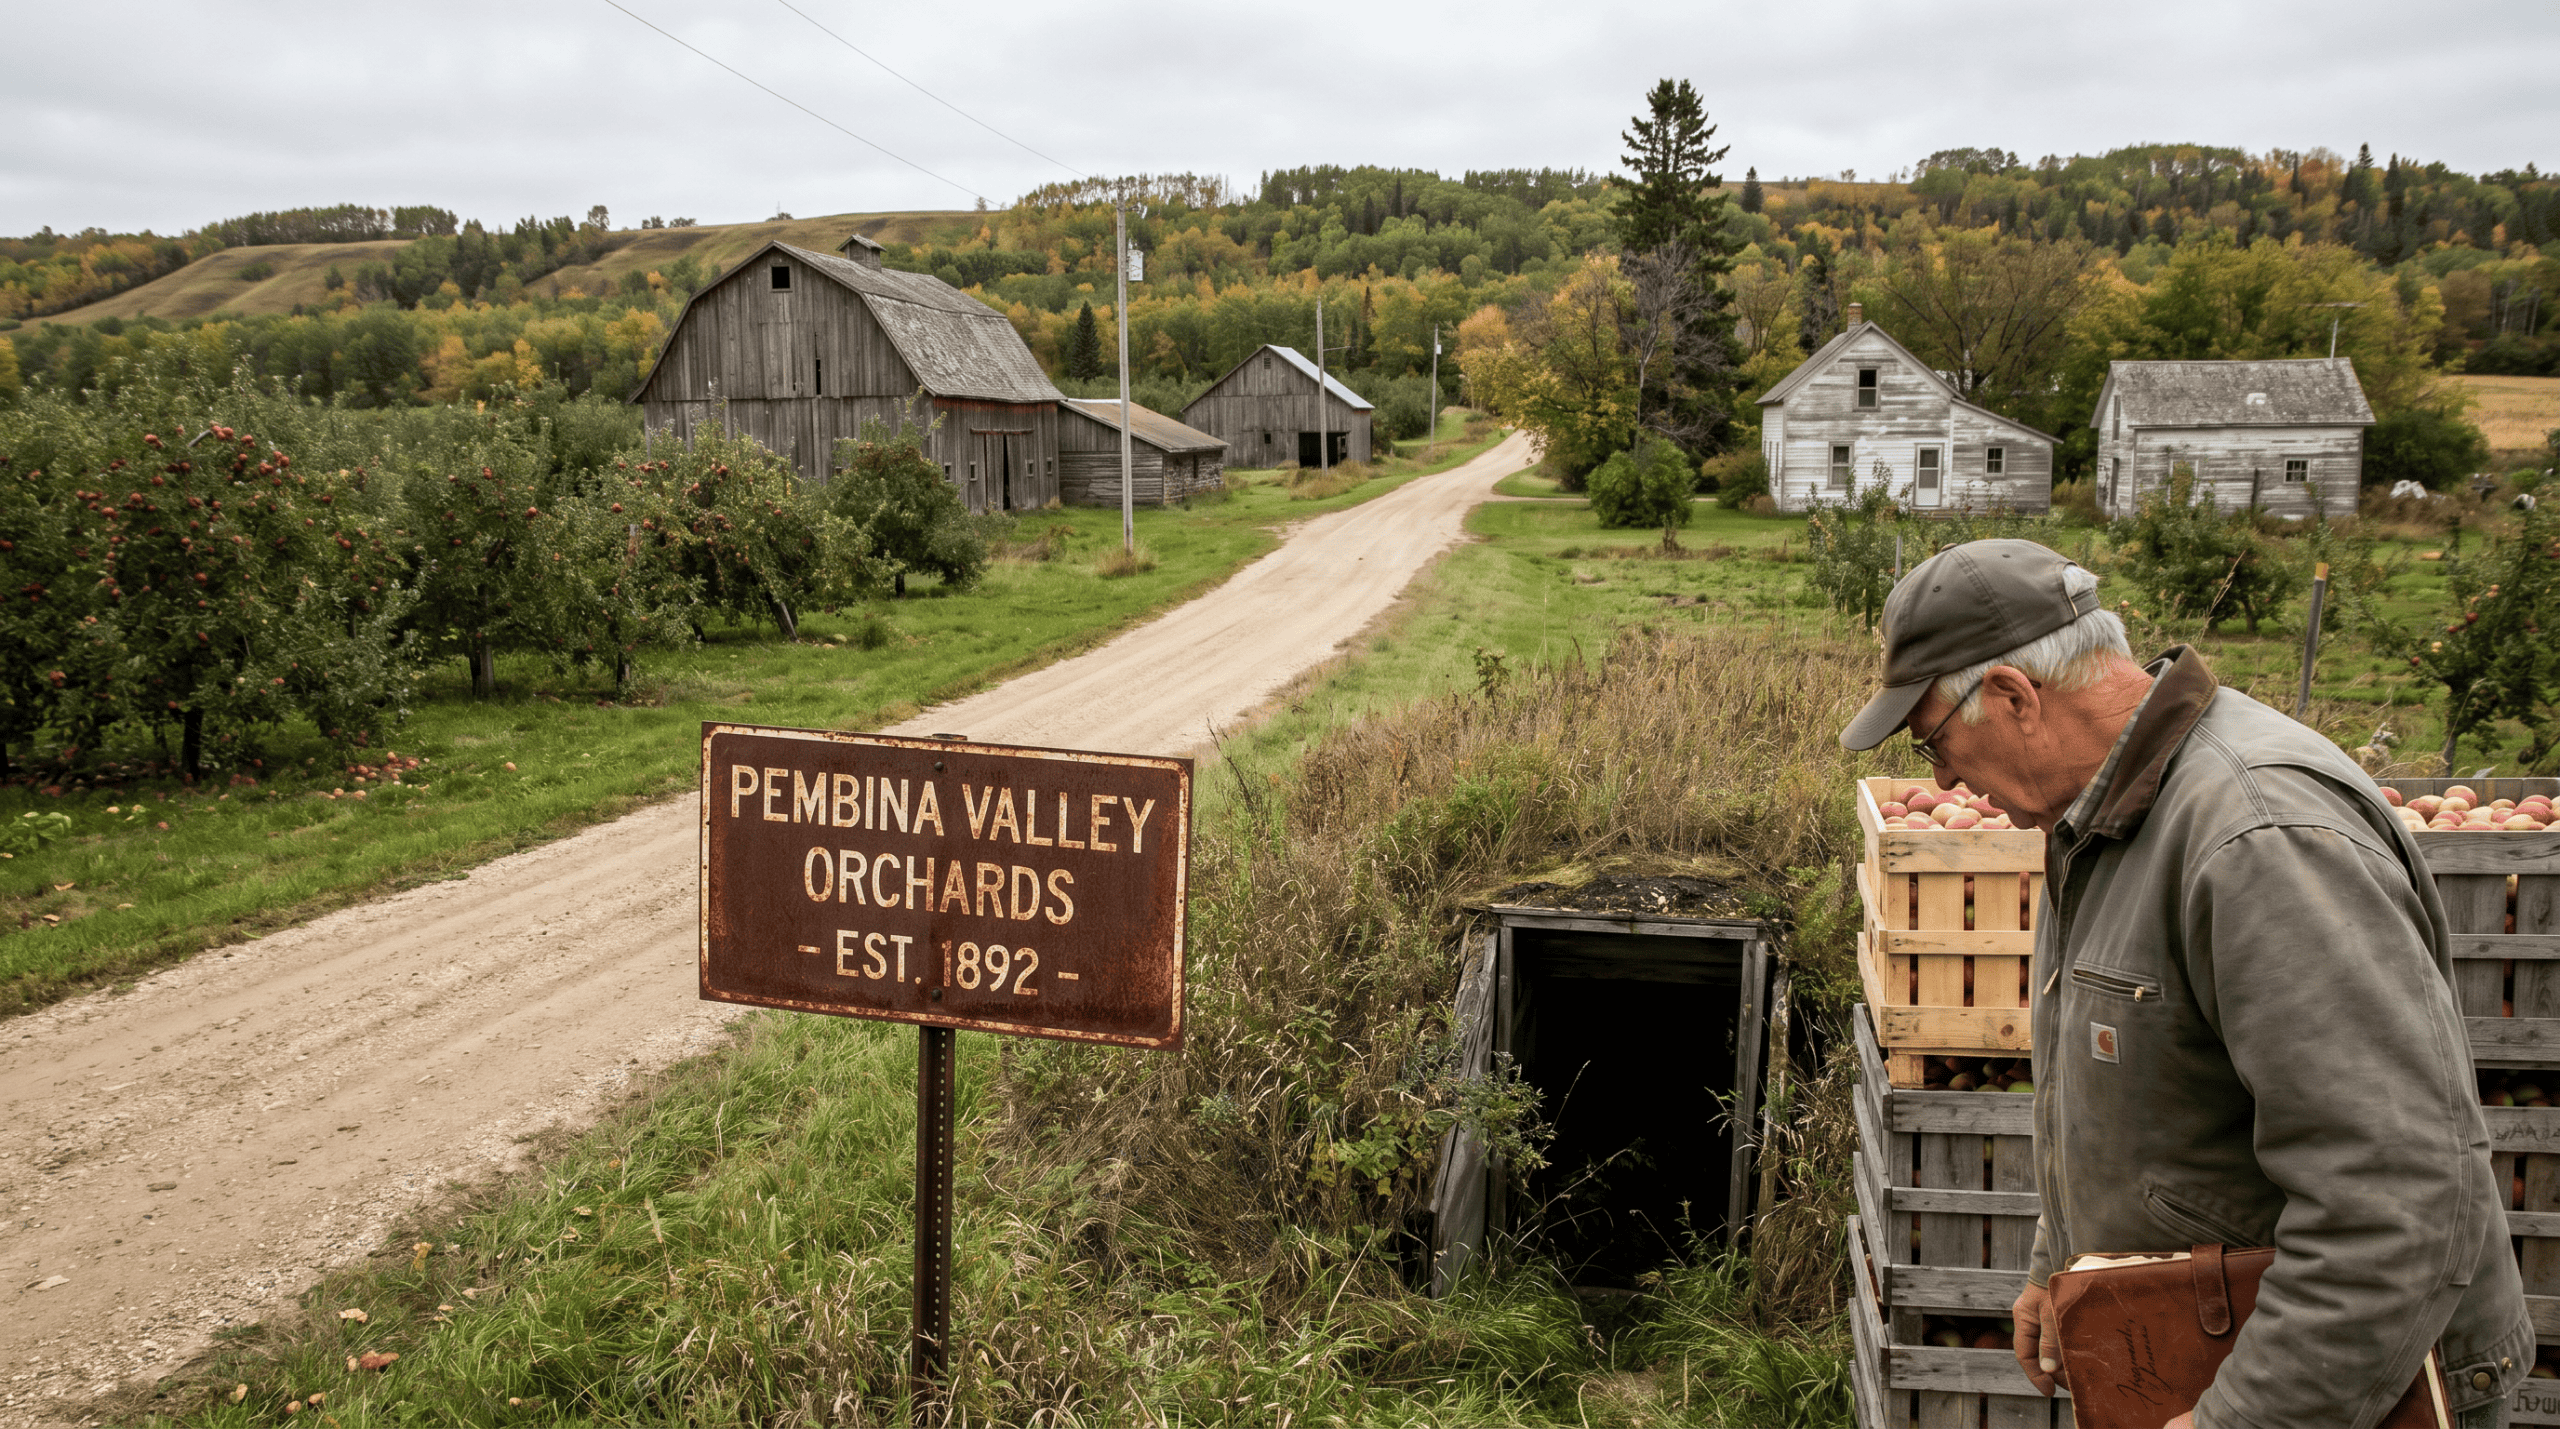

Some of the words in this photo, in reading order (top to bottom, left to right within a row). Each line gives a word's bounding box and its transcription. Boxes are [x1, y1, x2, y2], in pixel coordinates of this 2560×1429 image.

[731, 764, 945, 837] PEMBINA
[961, 783, 1156, 854] VALLEY
[804, 846, 1075, 925] ORCHARDS
[836, 928, 923, 985] EST.
[941, 939, 1039, 996] 1892
